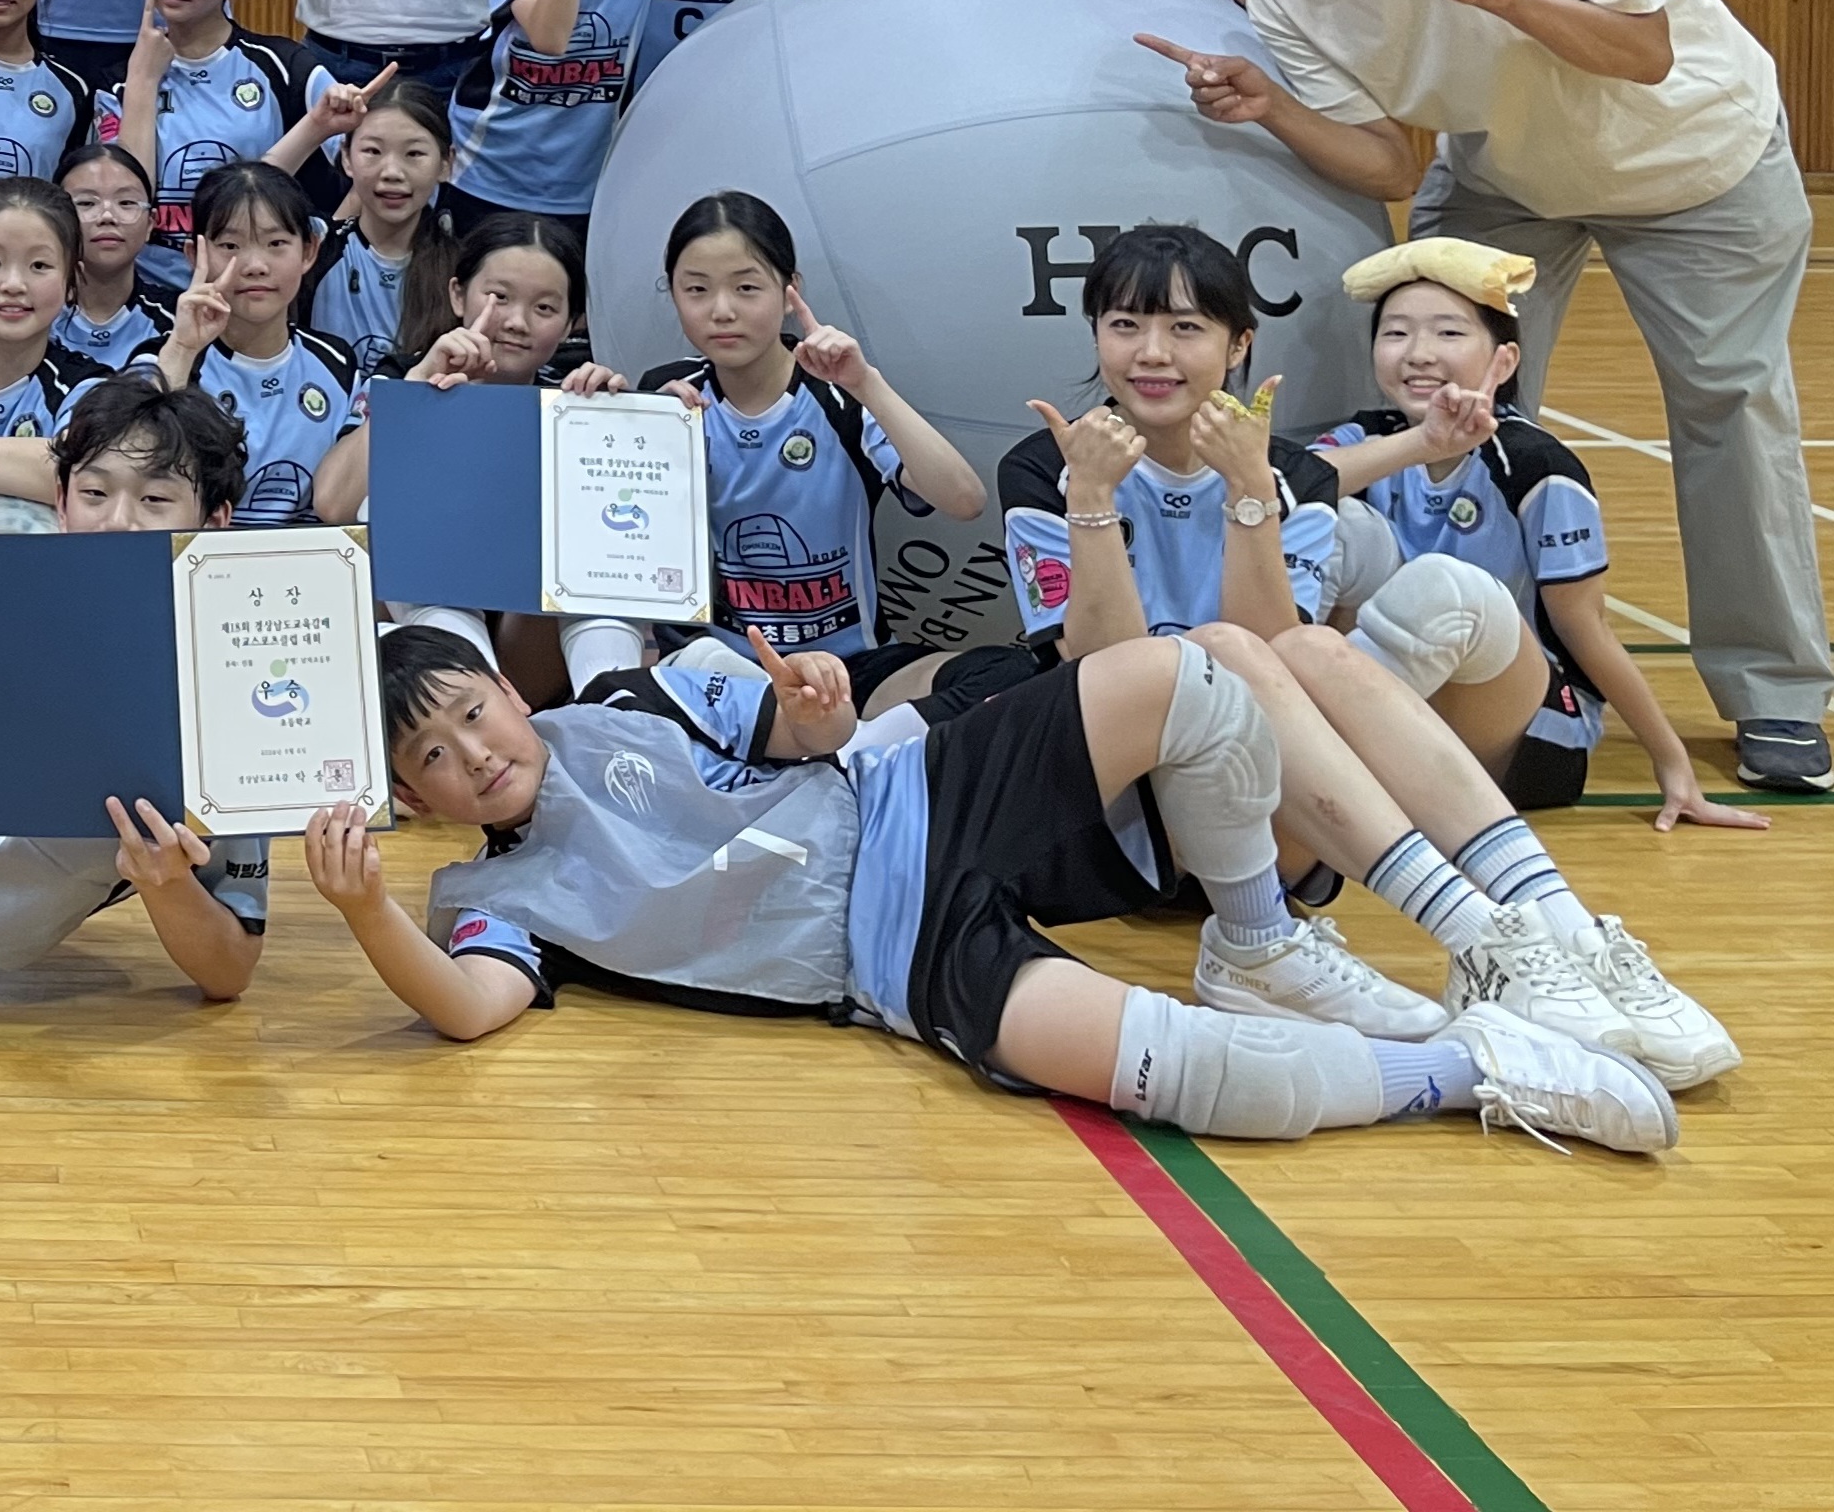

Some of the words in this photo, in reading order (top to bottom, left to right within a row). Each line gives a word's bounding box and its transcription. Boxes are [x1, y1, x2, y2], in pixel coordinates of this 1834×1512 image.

[1016, 225, 1303, 318] HC
[726, 573, 850, 612] INBALL
[1226, 968, 1273, 995] YONEX
